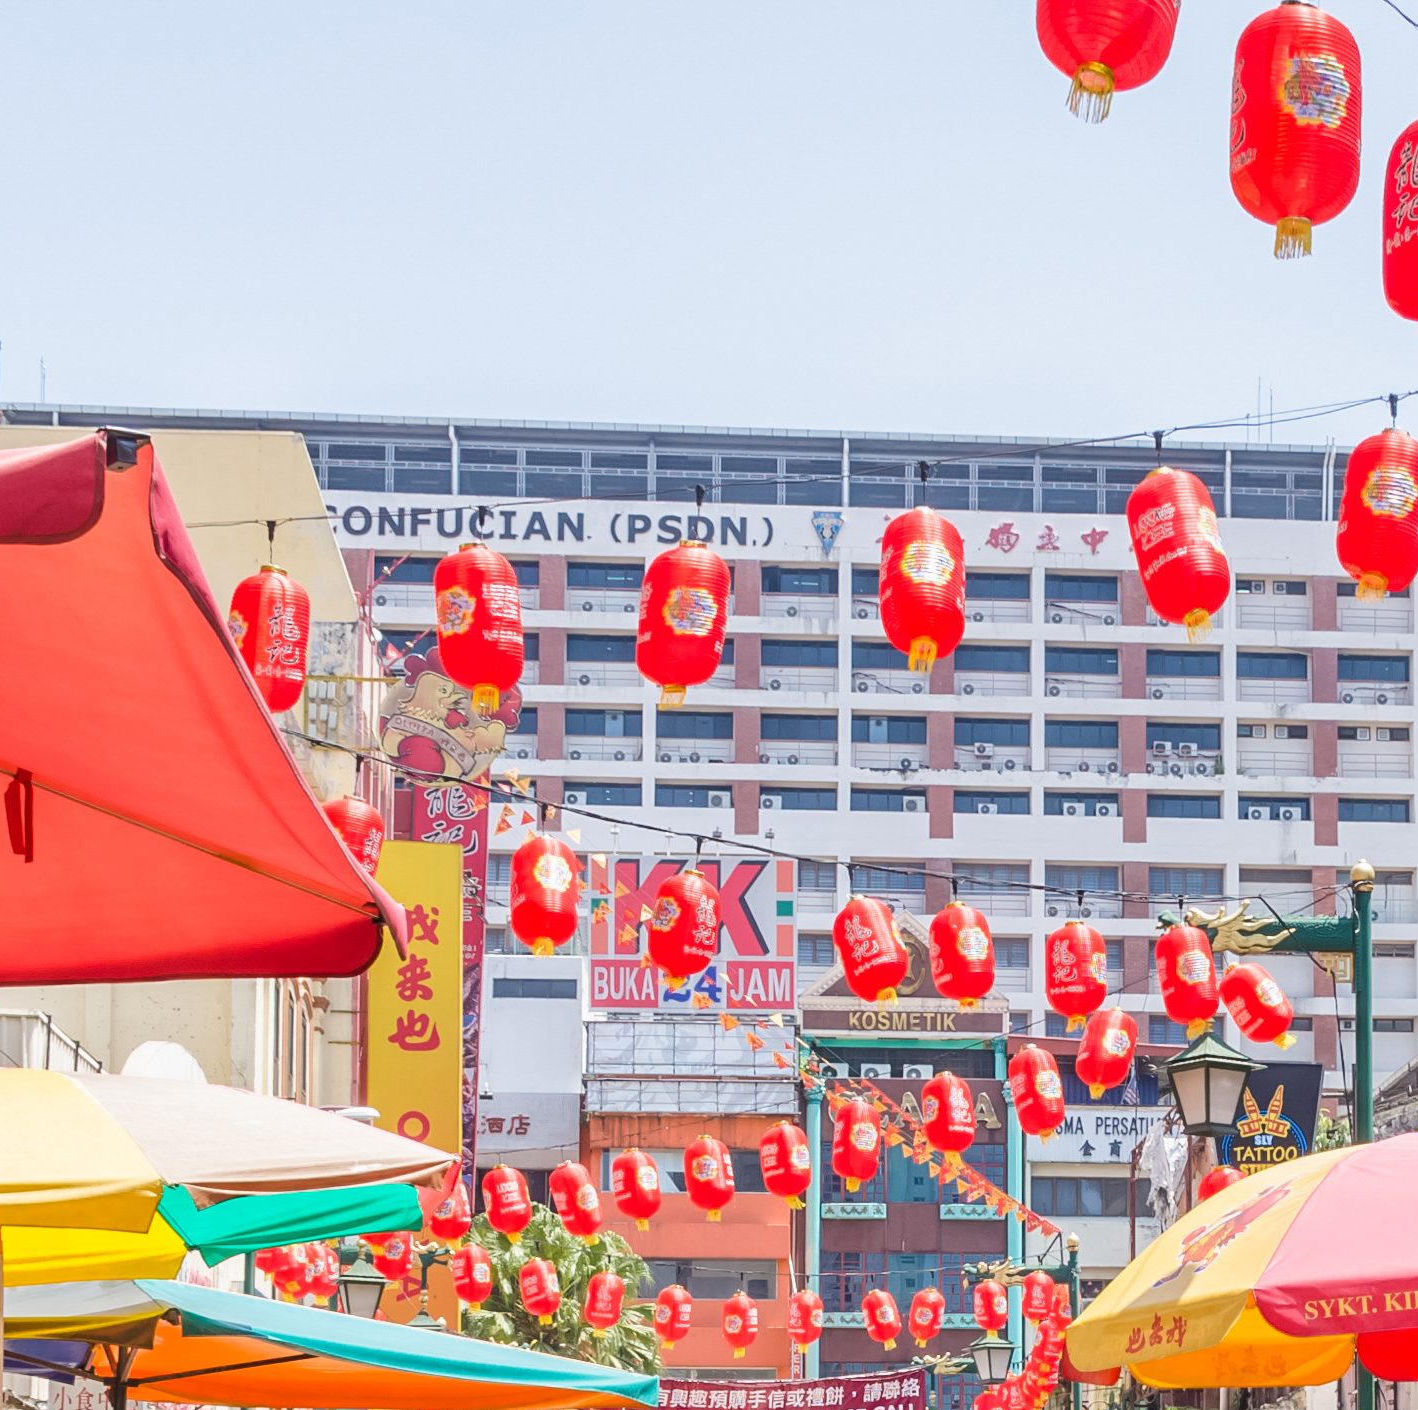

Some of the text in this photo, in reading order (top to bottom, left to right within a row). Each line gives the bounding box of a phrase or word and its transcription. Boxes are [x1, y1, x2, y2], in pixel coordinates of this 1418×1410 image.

[615, 860, 770, 956] KK
[594, 966, 656, 1001] BUKA
[730, 968, 791, 1003] JAM
[848, 1011, 957, 1032] KOSMETIK
[1234, 1146, 1298, 1162] TATTOO
[1304, 1295, 1378, 1323] SYKT.
